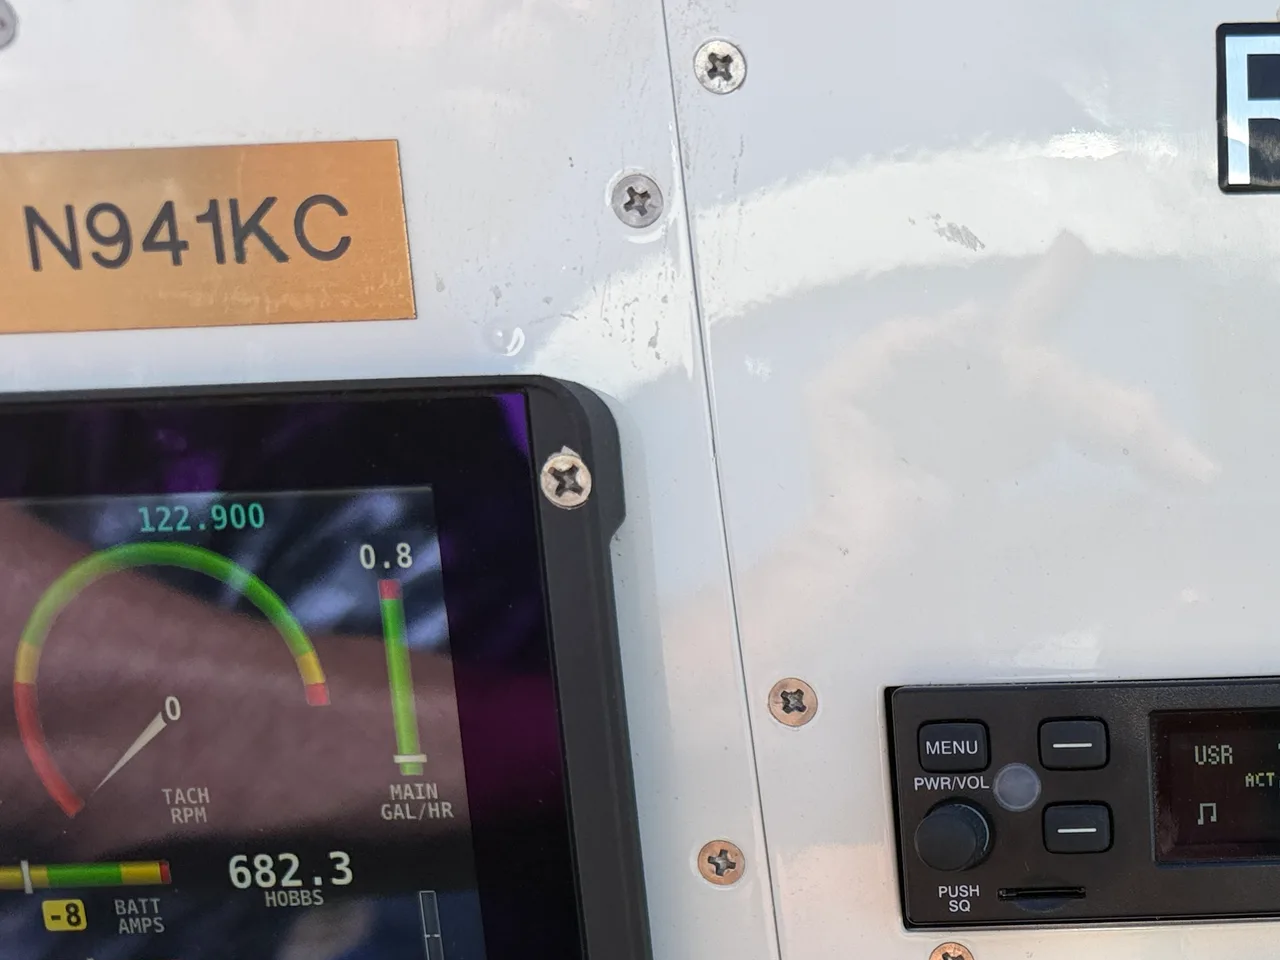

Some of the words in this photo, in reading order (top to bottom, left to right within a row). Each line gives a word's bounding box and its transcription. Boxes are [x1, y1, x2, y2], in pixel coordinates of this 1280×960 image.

[24, 194, 352, 272] N941KC
[139, 503, 266, 533] 122.900
[359, 543, 413, 569] 0.8
[164, 696, 182, 721] 0
[926, 740, 978, 755] MENU
[1194, 745, 1233, 765] USR
[914, 776, 990, 791] PWR/VOL
[1245, 772, 1275, 787] ACT
[162, 787, 210, 805] TACH
[390, 783, 438, 800] MAIN
[171, 806, 207, 823] RPM
[380, 802, 454, 820] GAL/HR
[228, 851, 353, 889] 682.3
[265, 890, 324, 907] HOBBS
[938, 885, 980, 898] PUSH
[50, 904, 82, 926] -8
[115, 899, 161, 916] BATT
[948, 900, 971, 913] SQ
[118, 917, 165, 935] AMPS
